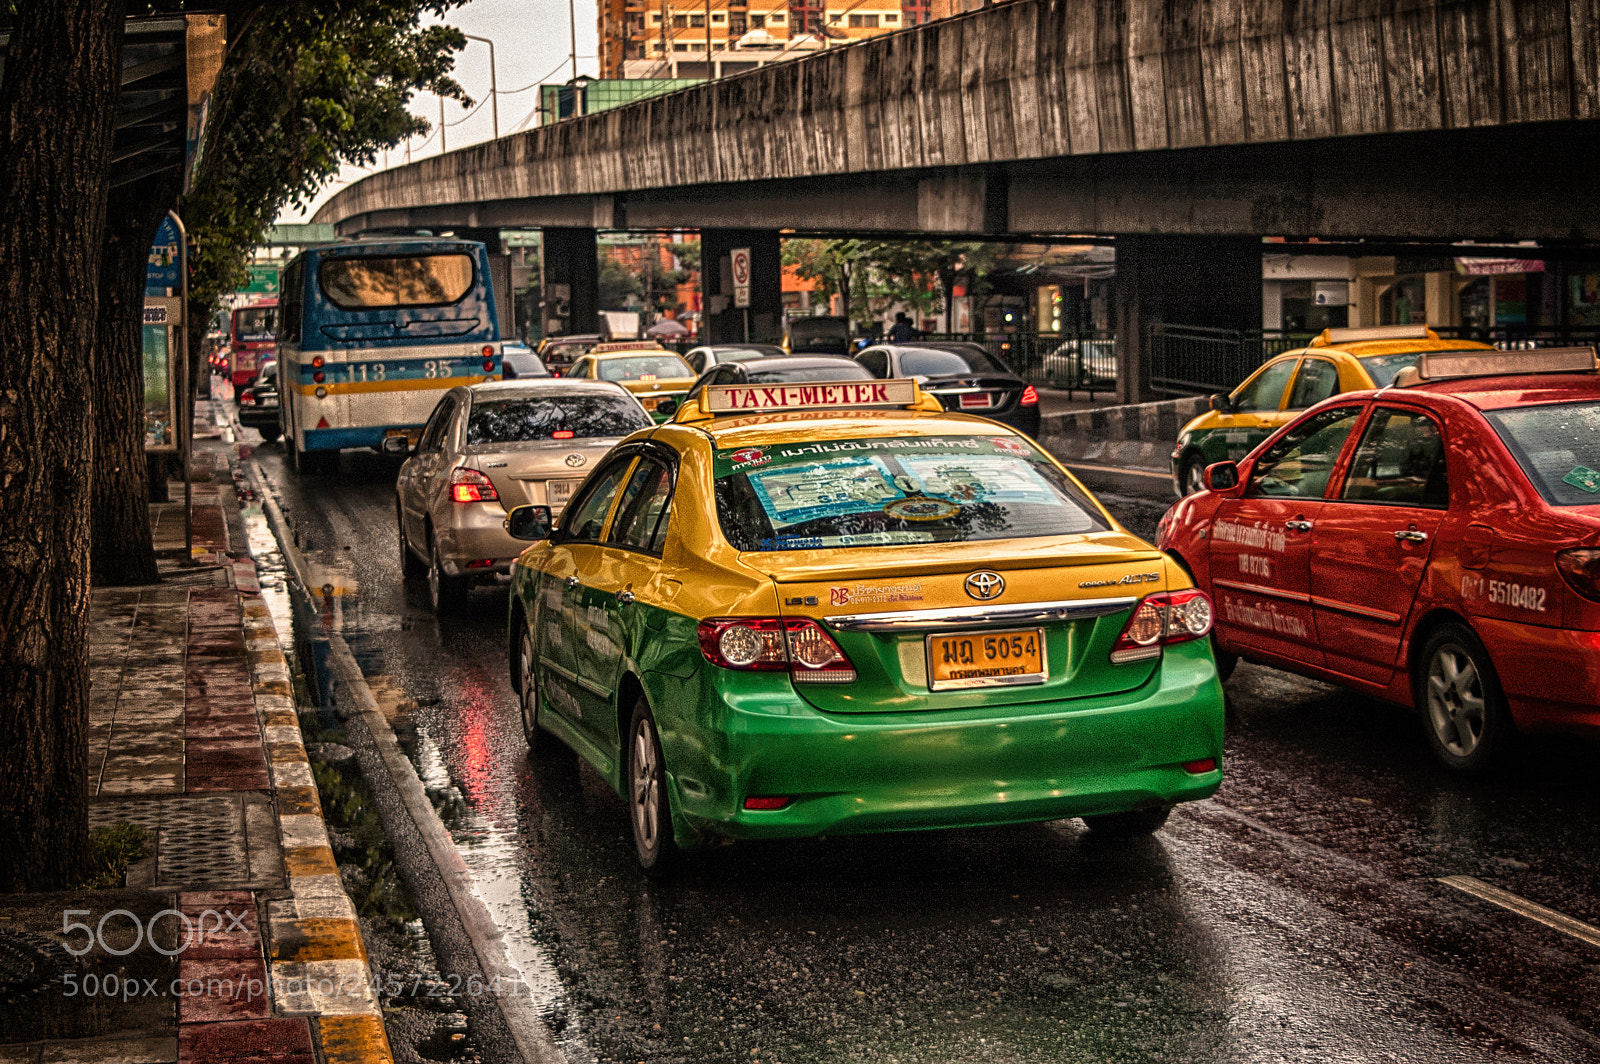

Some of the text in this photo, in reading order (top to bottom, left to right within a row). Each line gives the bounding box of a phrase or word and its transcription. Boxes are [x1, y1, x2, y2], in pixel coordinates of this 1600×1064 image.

[424, 360, 453, 379] 35
[725, 383, 889, 408] TAXI-METER
[1118, 572, 1160, 585] ALTIS
[1488, 580, 1546, 611] 5518482
[984, 636, 1036, 659] 5054
[949, 666, 1025, 679] กรุงเทพมหานคร
